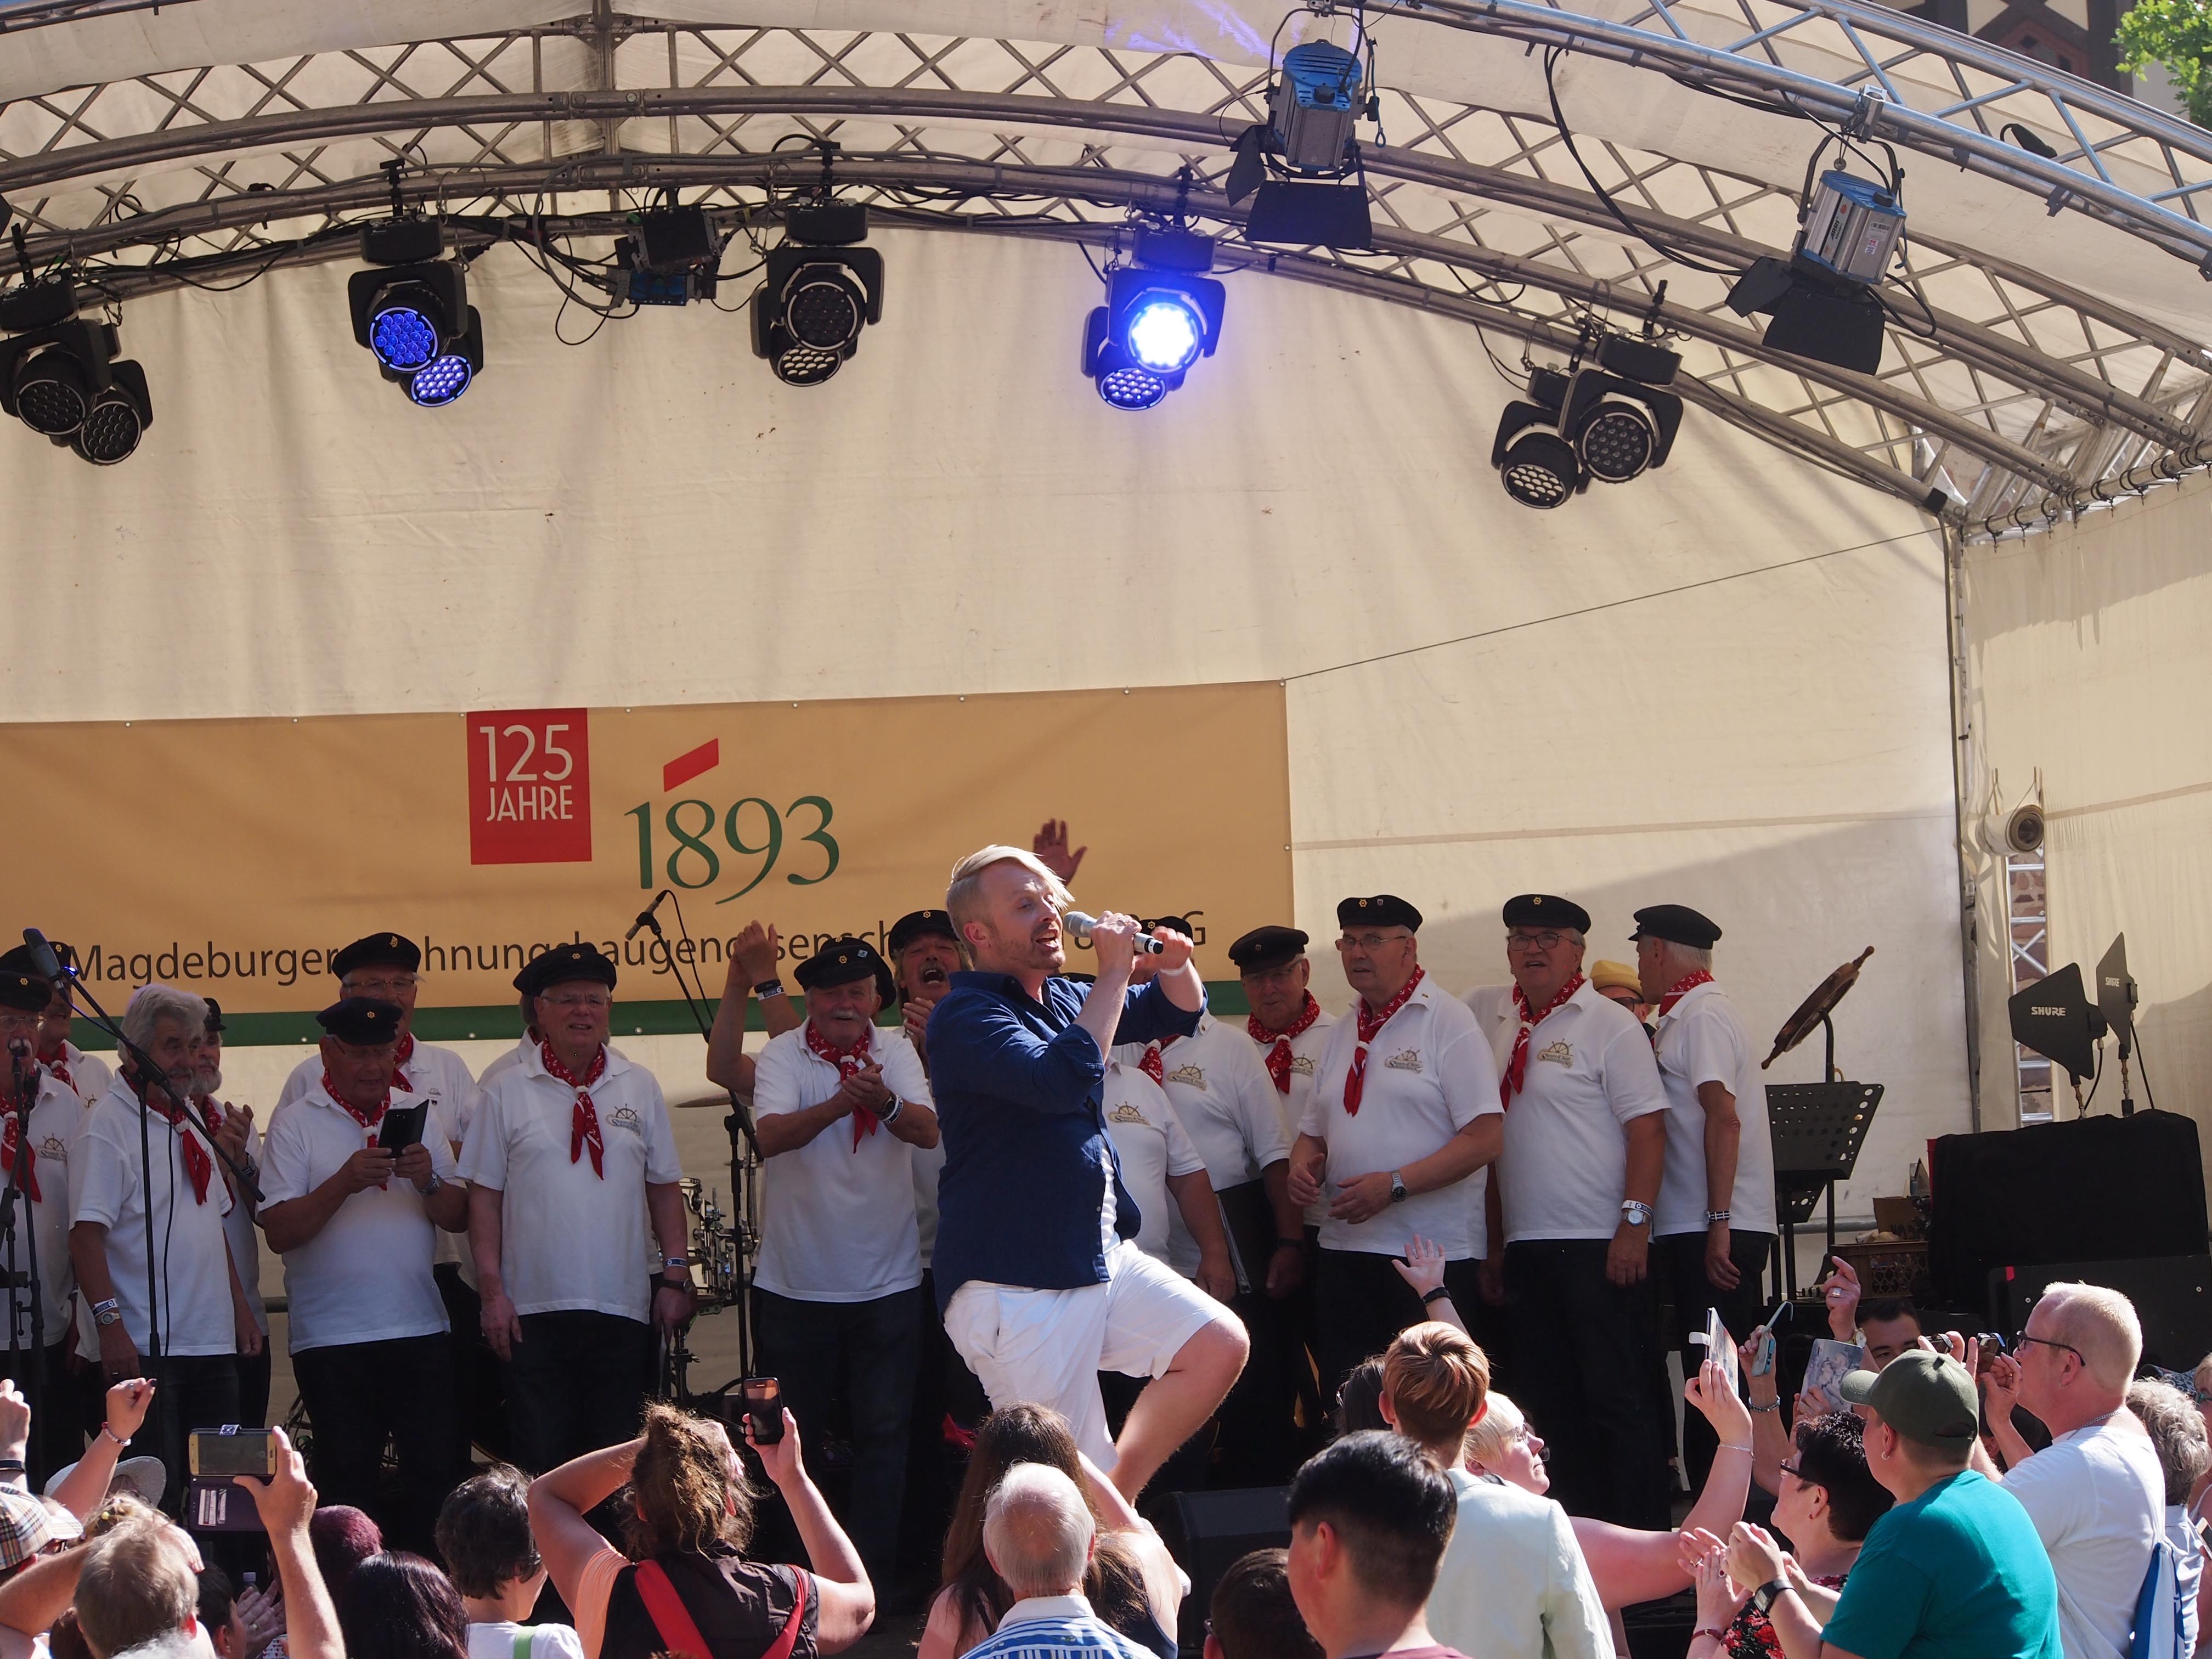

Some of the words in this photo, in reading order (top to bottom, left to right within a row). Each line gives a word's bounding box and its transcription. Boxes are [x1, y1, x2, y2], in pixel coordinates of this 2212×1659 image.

[1831, 220, 1839, 240] ARRI
[479, 724, 573, 782] 125
[486, 785, 573, 822] JAHRE
[624, 795, 840, 905] 1893
[69, 940, 338, 990] Magdeburger
[2105, 977, 2120, 987] SHURE
[2031, 1006, 2067, 1017] SHURE
